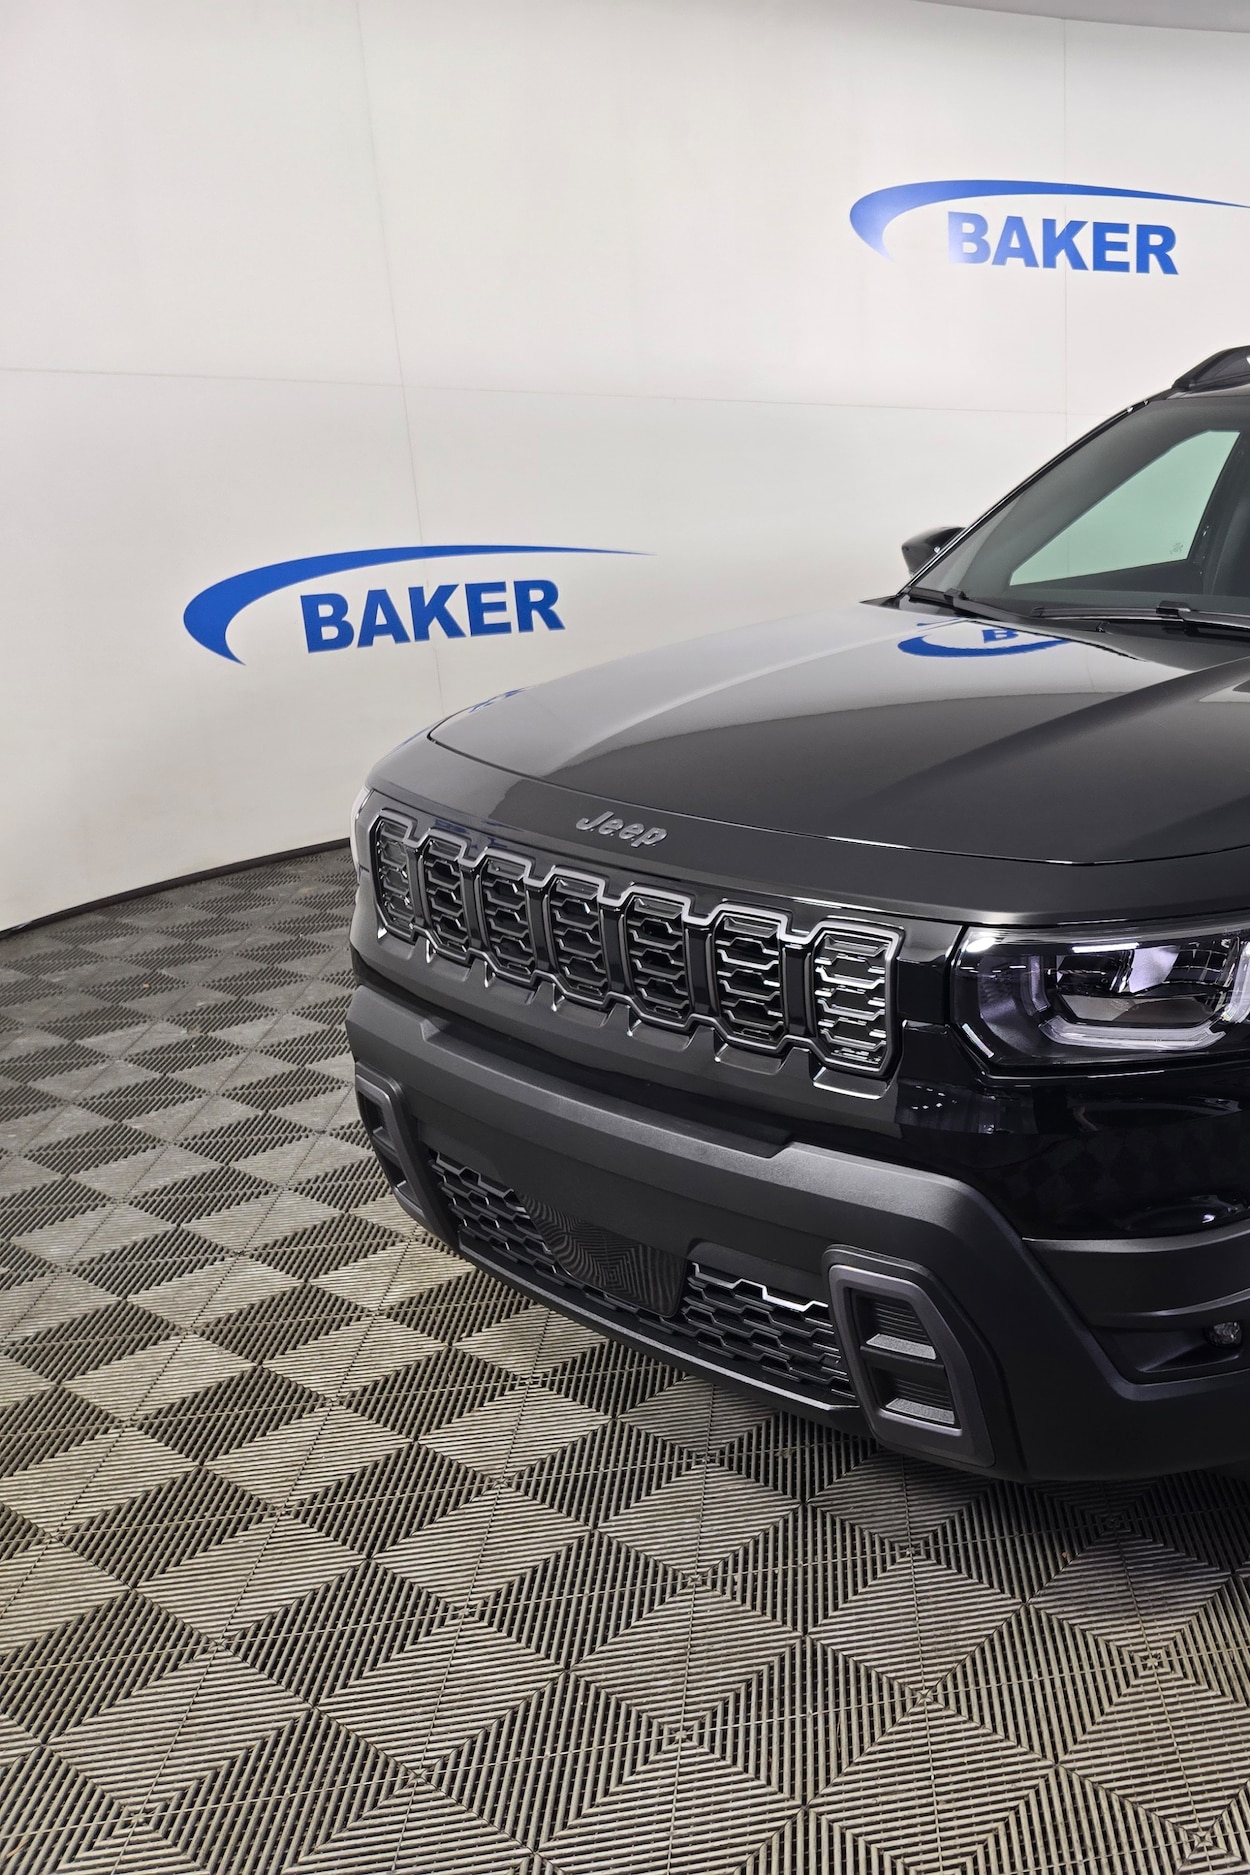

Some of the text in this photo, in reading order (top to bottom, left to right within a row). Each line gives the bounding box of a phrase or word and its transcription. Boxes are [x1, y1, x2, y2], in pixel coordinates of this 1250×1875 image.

[948, 211, 1179, 276] BAKER
[300, 579, 566, 653] BAKER
[575, 810, 667, 848] Jeep
